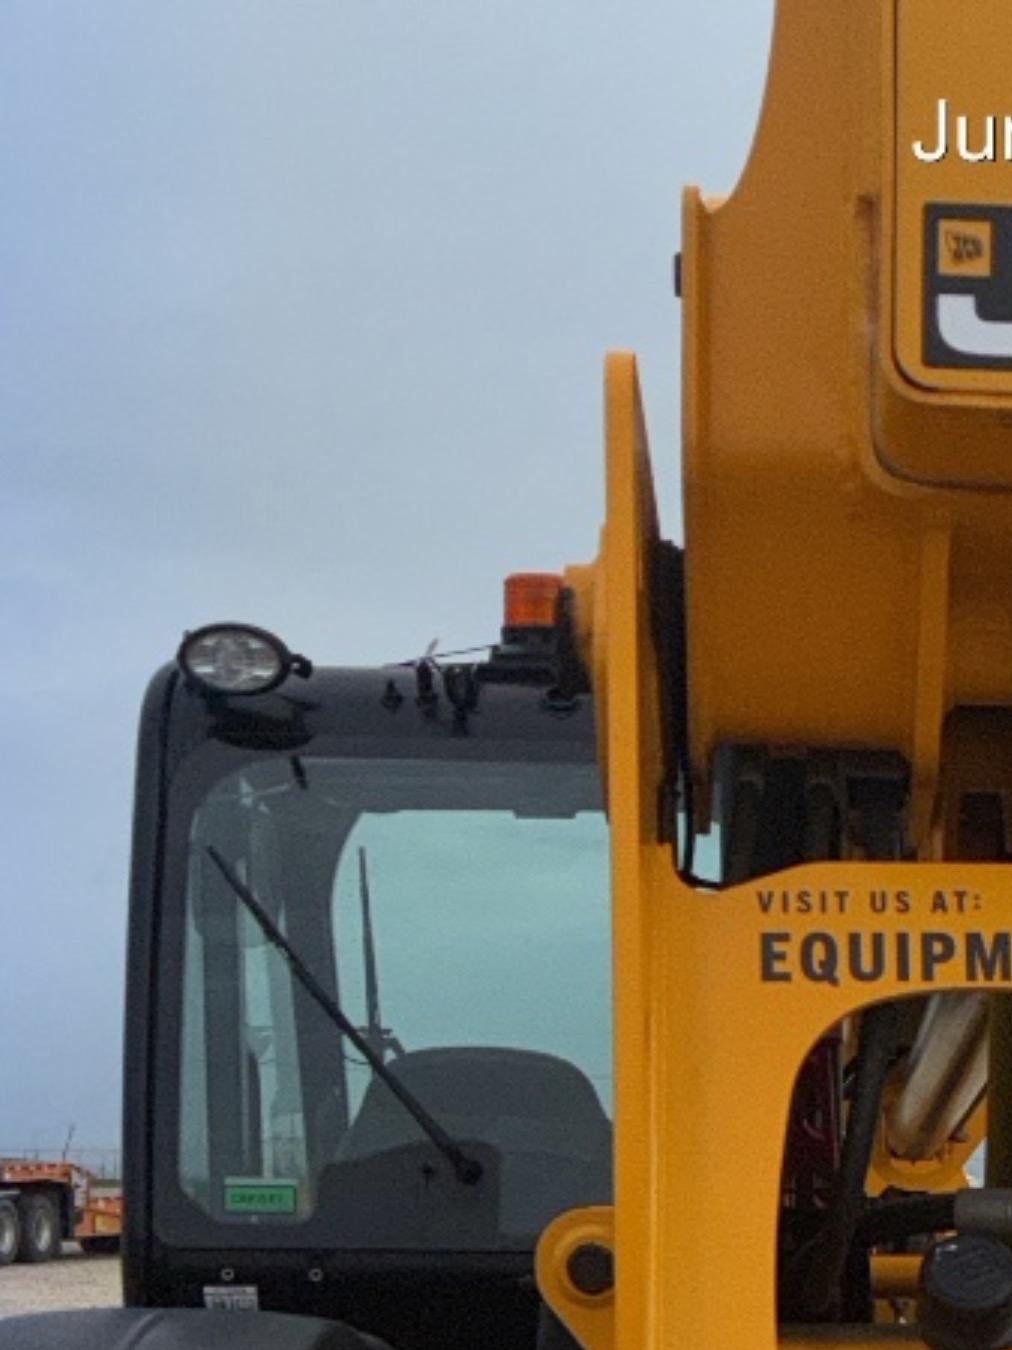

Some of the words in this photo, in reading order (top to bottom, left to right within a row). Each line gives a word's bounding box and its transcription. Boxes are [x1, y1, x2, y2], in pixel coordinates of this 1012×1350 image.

[757, 890, 850, 913] VISIT
[869, 890, 913, 914] US
[931, 890, 983, 914] AT:
